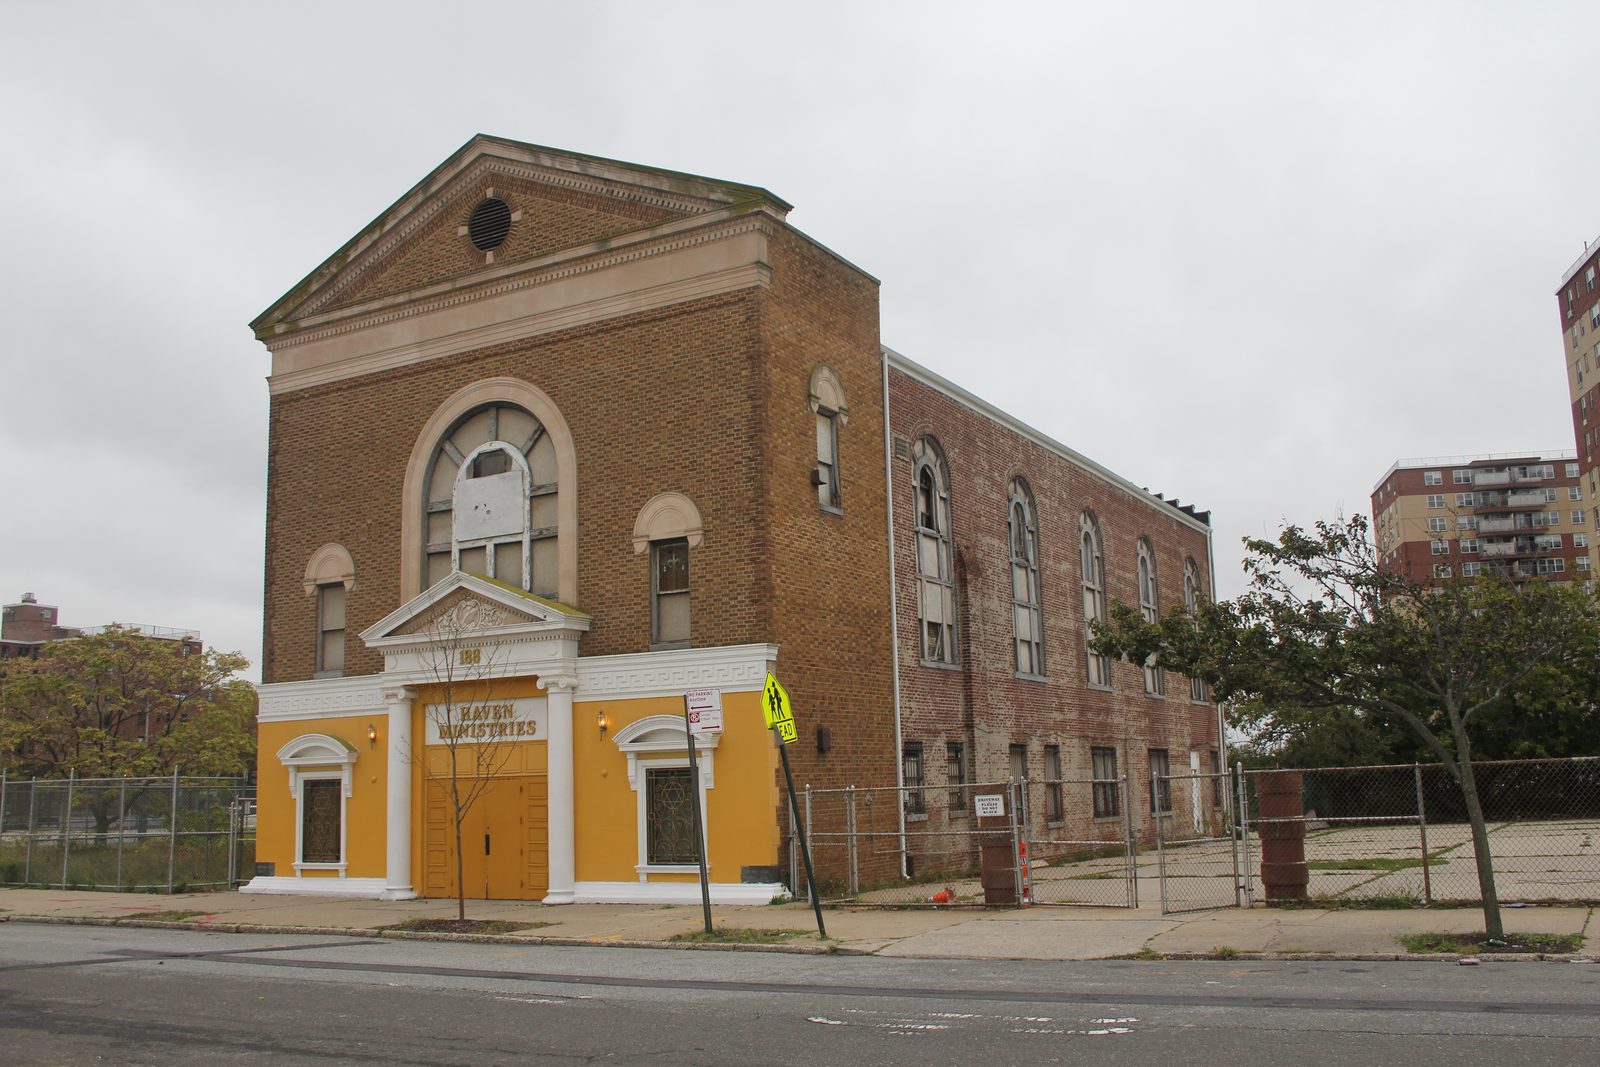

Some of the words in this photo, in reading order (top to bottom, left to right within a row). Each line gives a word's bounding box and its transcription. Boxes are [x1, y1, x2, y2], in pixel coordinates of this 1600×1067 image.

[460, 704, 513, 721] HAVEN
[439, 720, 536, 739] MINISTRIES
[779, 723, 793, 738] EAD
